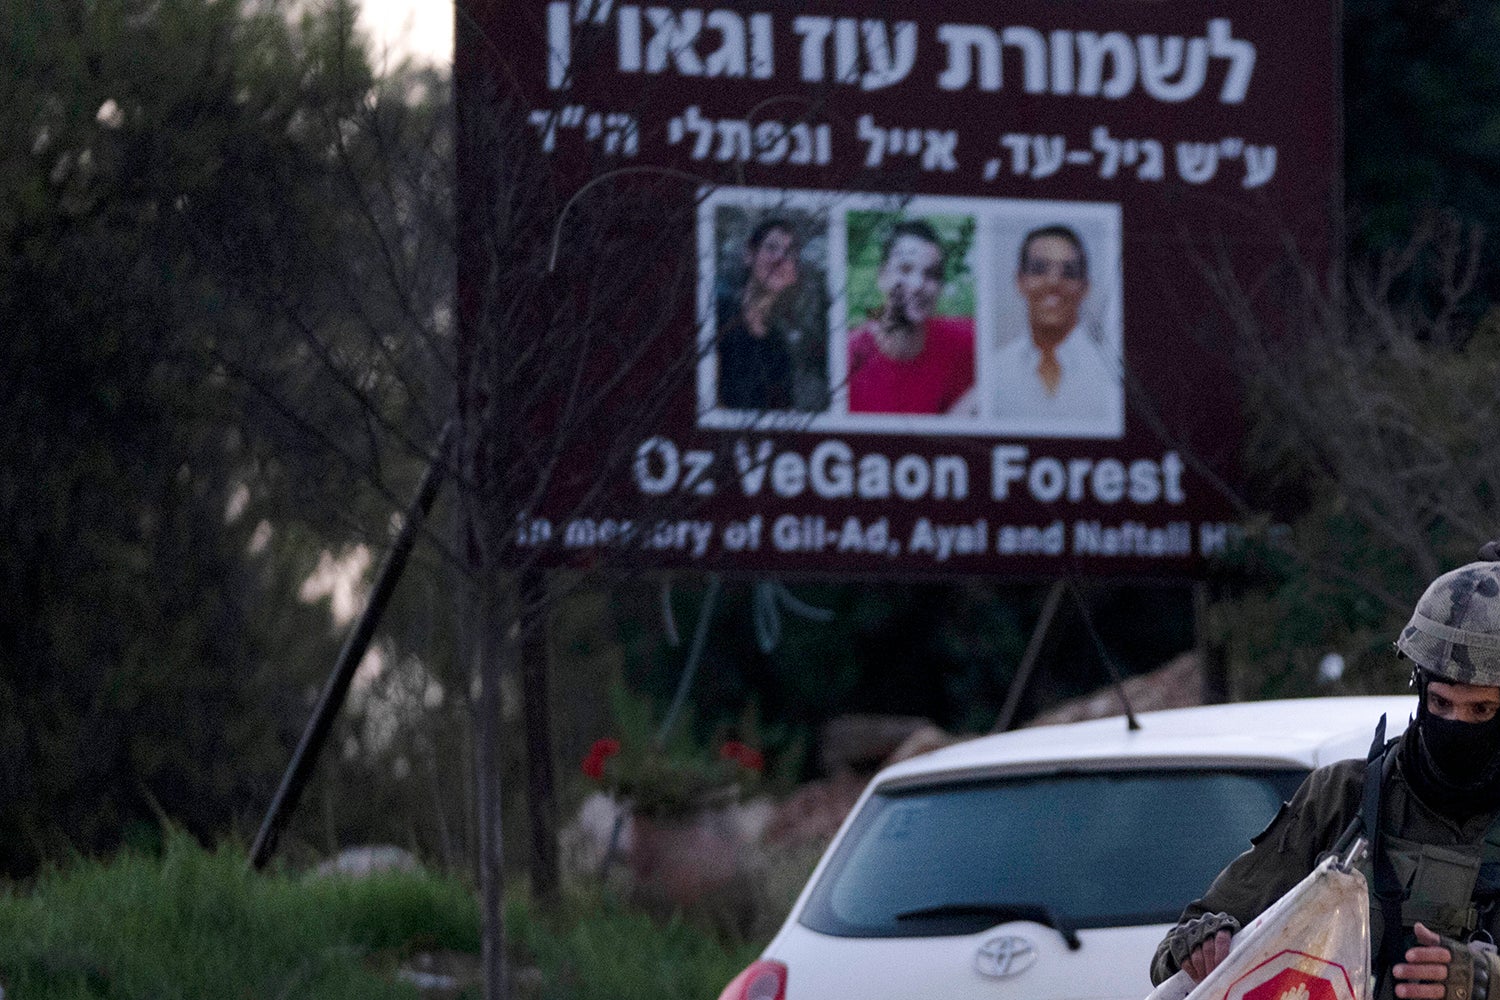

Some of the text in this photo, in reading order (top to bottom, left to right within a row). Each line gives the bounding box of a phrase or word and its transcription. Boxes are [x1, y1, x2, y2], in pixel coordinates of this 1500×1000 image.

[937, 18, 1257, 103] לשמורת
[667, 106, 831, 165] ונפתלי
[857, 113, 959, 171] אייל
[634, 437, 1184, 503] Oz VeGaon Forest
[723, 515, 763, 551] of
[909, 517, 989, 561] Ayal
[997, 520, 1065, 556] and
[1073, 521, 1191, 558] Naftali
